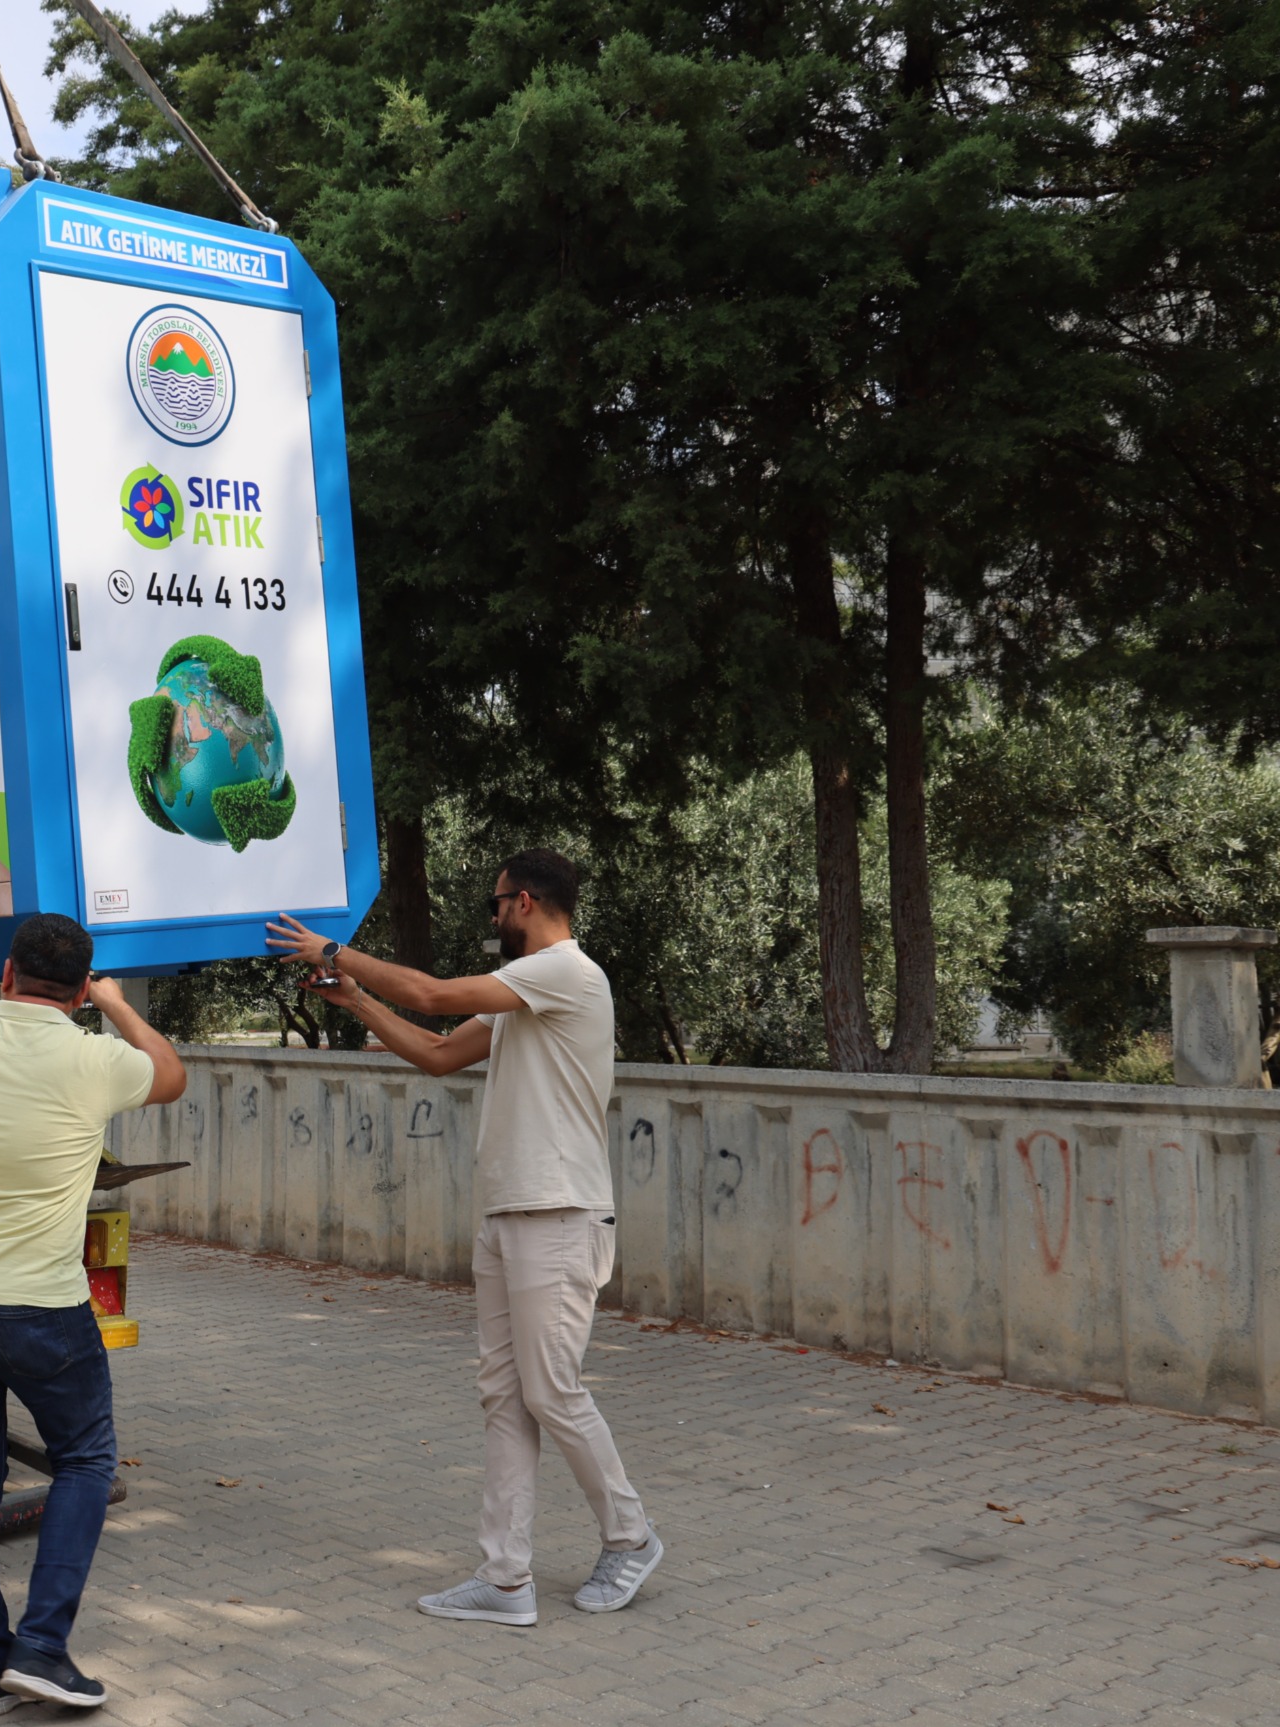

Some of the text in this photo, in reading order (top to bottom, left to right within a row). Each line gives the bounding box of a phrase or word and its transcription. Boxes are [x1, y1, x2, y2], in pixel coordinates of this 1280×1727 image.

[60, 219, 268, 279] ATIK GETİRME MERKEZİ
[139, 320, 225, 398] MERSİN TOROSLAR BELEDİYESİ
[187, 476, 262, 513] SIFIR
[192, 511, 265, 549] ATIK
[146, 572, 286, 611] 444 4 133
